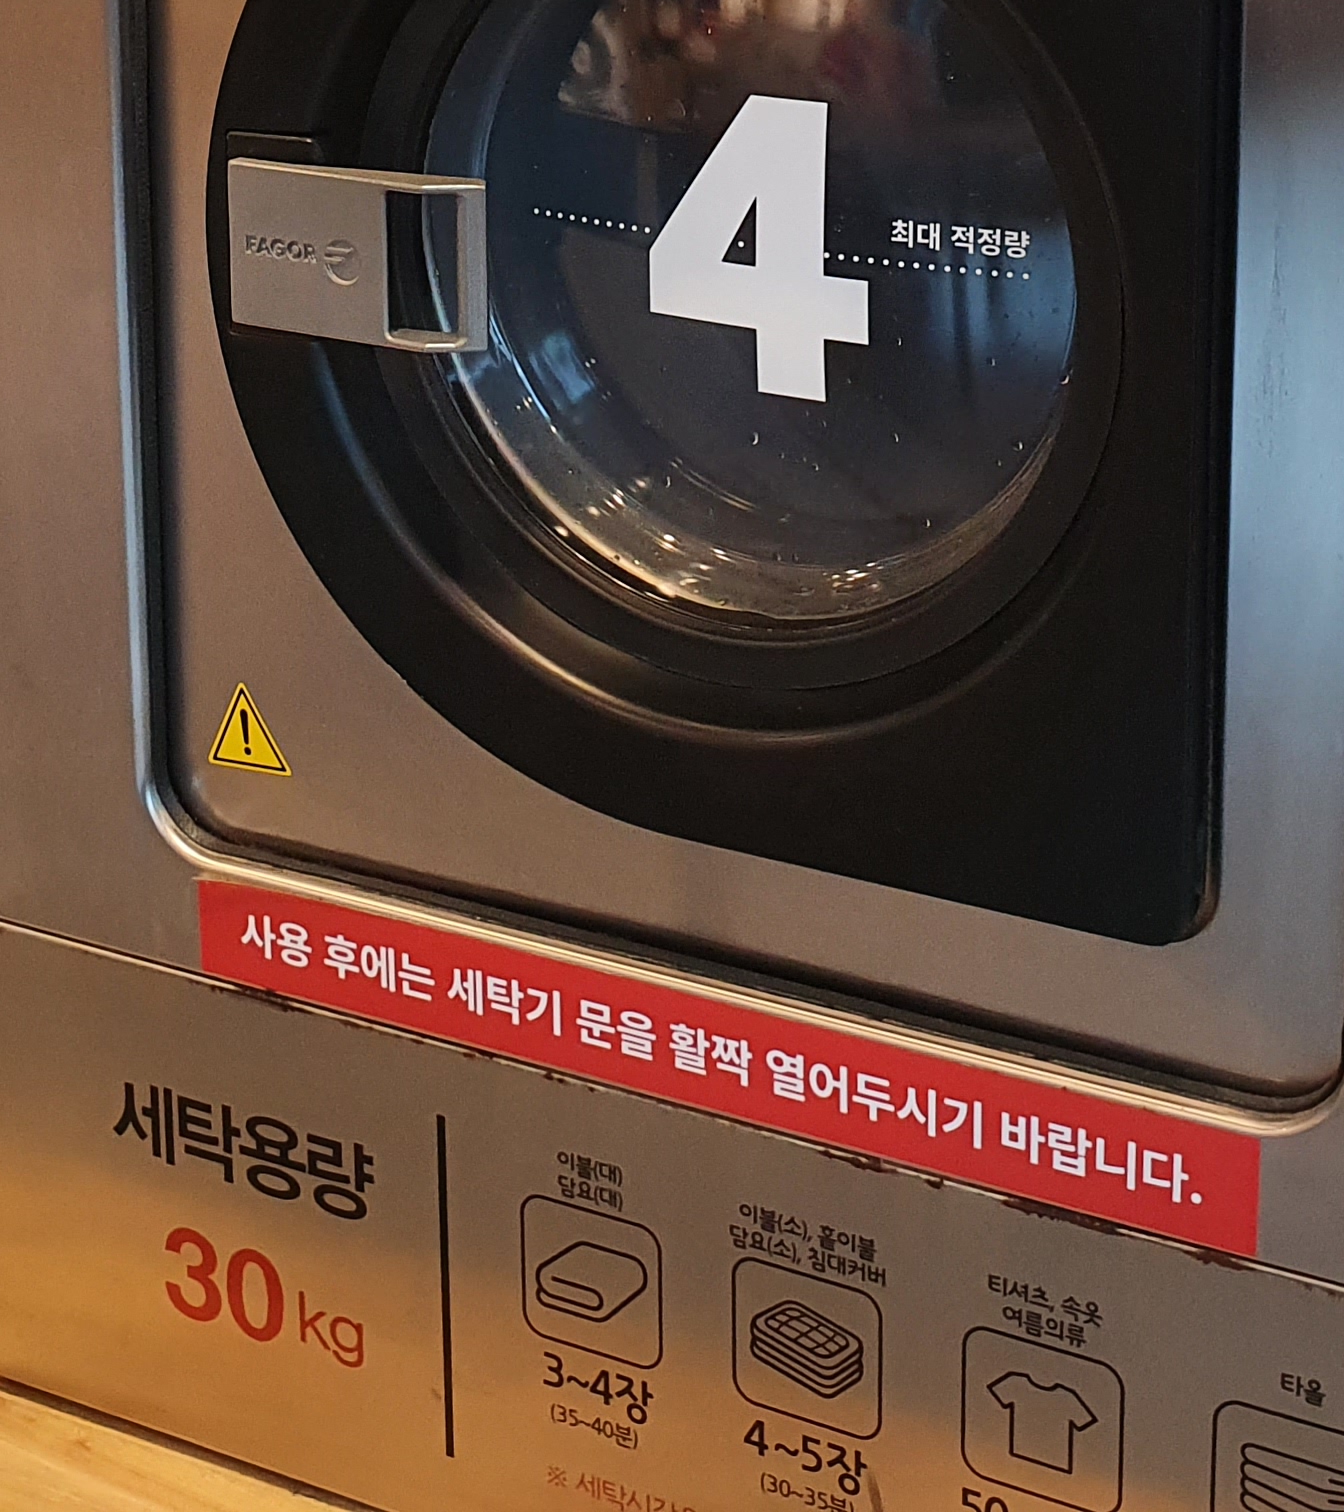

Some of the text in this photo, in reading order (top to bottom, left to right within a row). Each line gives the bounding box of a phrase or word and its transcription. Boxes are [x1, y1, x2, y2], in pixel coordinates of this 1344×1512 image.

[245, 234, 318, 264] FAGOR
[650, 94, 869, 402] 4
[890, 220, 1031, 260] 최대 적정량
[240, 912, 1204, 1207] 사용 후에는 세탁기 문을 활짝 열어두시기 바랍니다.
[113, 1081, 375, 1221] 세탁용량
[556, 1150, 624, 1187] 이불(대)
[556, 1174, 624, 1213] 담요(대)
[738, 1202, 812, 1247] 이불(소),
[728, 1224, 888, 1288] 담요(소), 침대커버
[164, 1226, 283, 1342] 30
[987, 1274, 1104, 1329] 티셔츠, 속옷
[1001, 1304, 1087, 1349] 여름의류
[542, 1350, 654, 1426] 3~4장
[1280, 1371, 1327, 1407] 타올
[550, 1402, 638, 1450] (35~40분)
[743, 1419, 867, 1497] 4~5장
